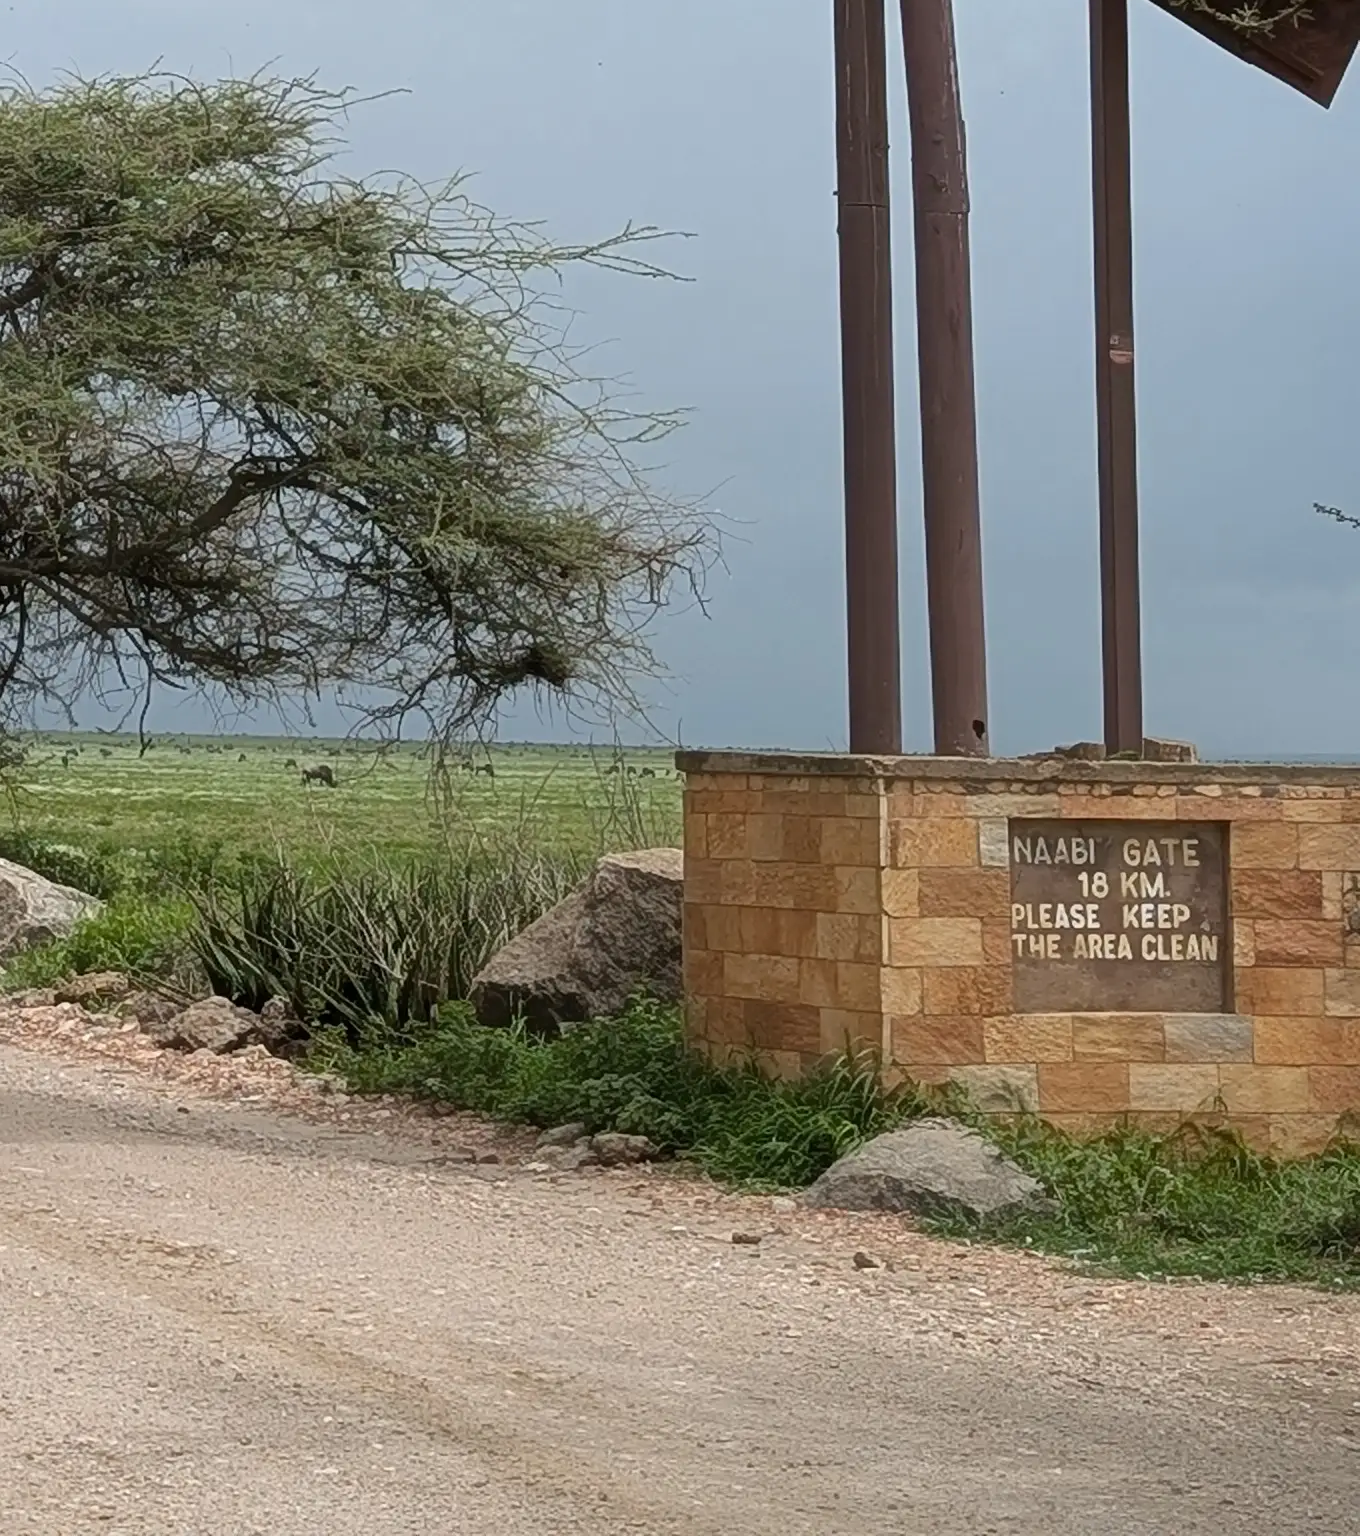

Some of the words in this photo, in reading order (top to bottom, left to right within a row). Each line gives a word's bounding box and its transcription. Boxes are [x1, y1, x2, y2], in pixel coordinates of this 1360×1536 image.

[1013, 836, 1095, 865] NAABI
[1122, 838, 1201, 867] GATE
[1078, 871, 1109, 899] 18
[1120, 871, 1171, 899] KM.
[1011, 903, 1101, 929] PLEASE
[1122, 903, 1191, 929] KEEP
[1011, 934, 1062, 959] THE
[1073, 934, 1133, 960] AREA
[1141, 934, 1218, 962] CLEAN
